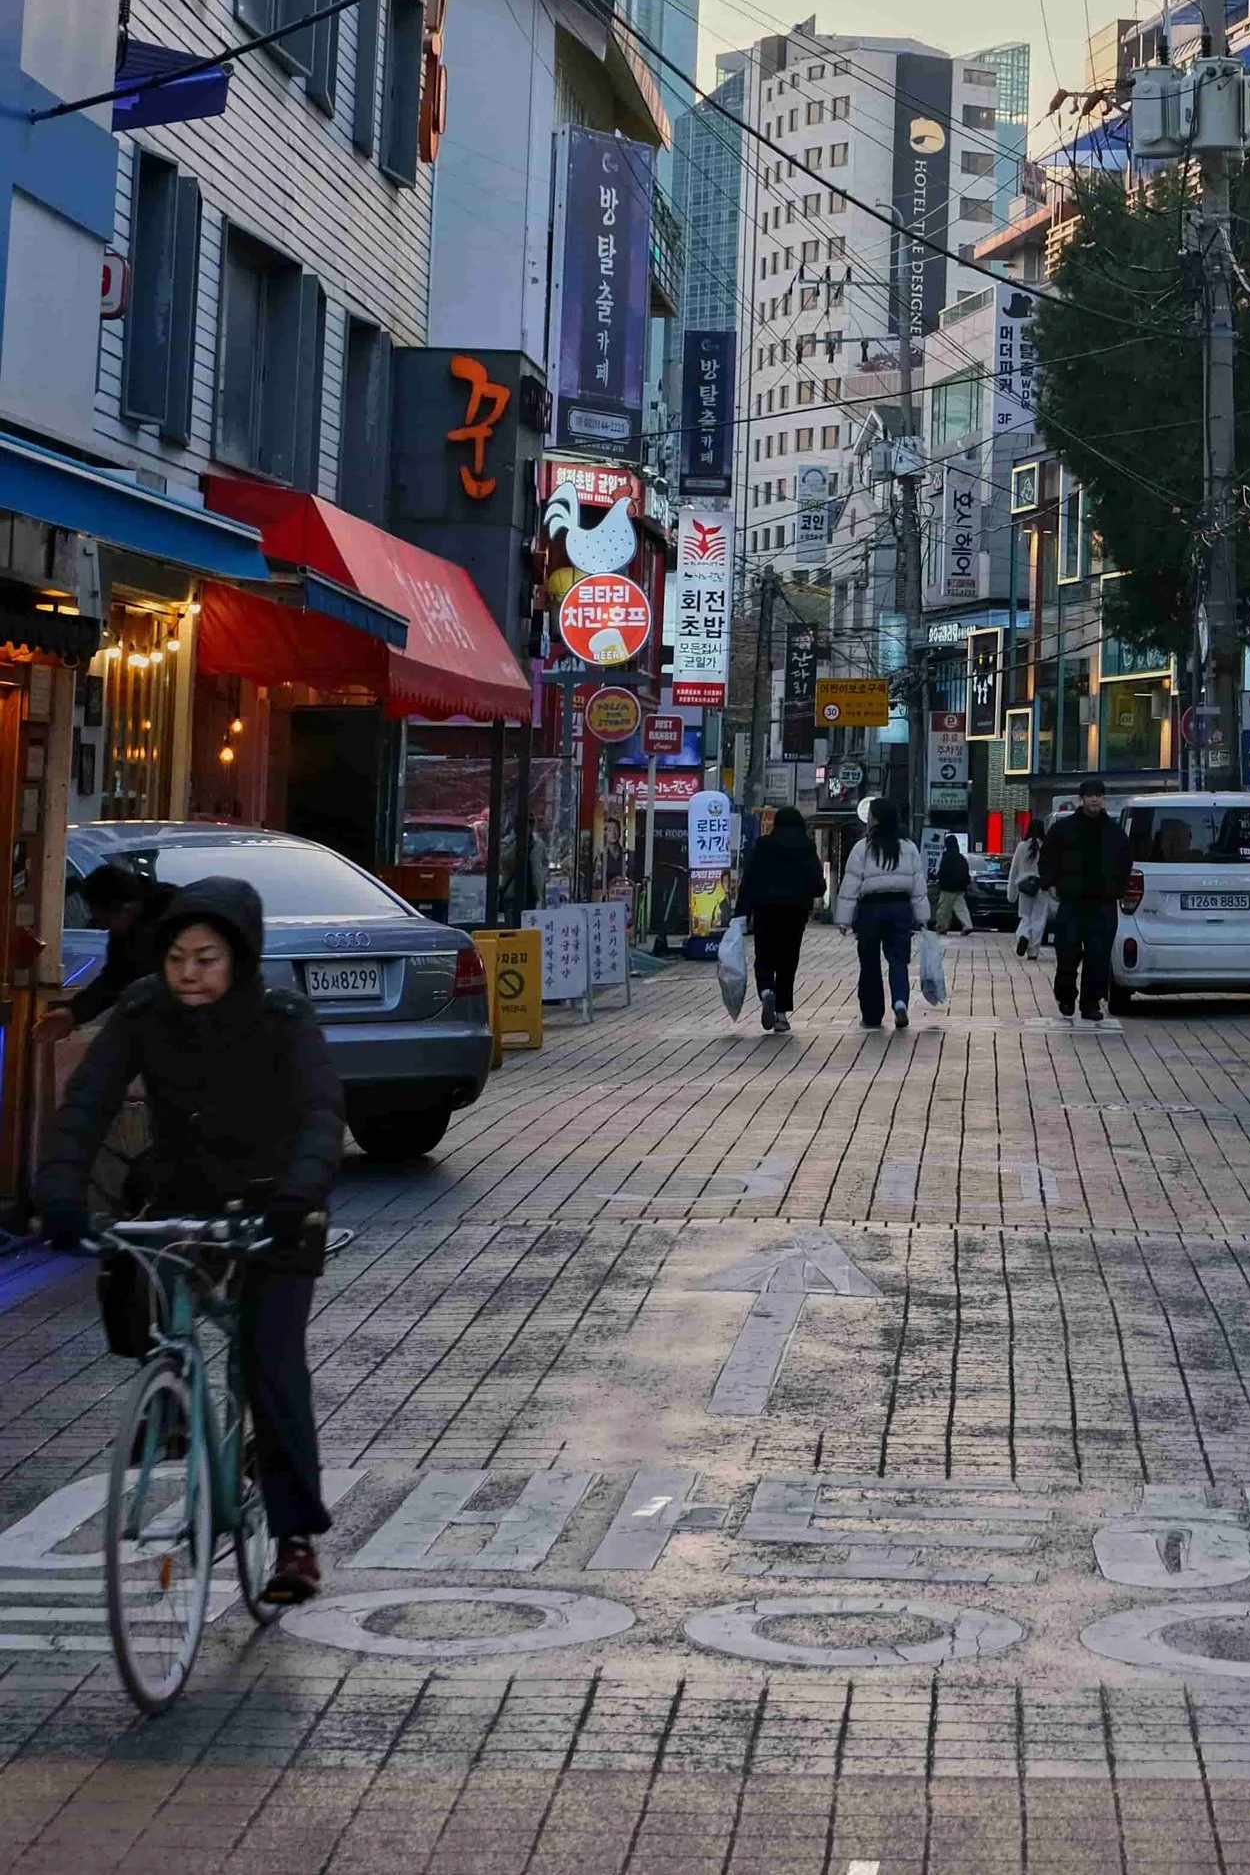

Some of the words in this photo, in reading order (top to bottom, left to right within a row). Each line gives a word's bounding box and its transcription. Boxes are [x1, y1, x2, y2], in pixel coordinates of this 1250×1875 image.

[913, 160, 928, 216] HOTEL
[997, 413, 1013, 425] 3F
[800, 514, 825, 531] 코인
[578, 585, 630, 604] 로타리
[680, 589, 726, 613] 회전
[678, 616, 726, 639] 초밥
[593, 650, 621, 661] BEER
[826, 707, 837, 717] 30
[654, 719, 673, 730] JUST
[1220, 895, 1248, 908] 8835
[497, 952, 529, 964] 차금지
